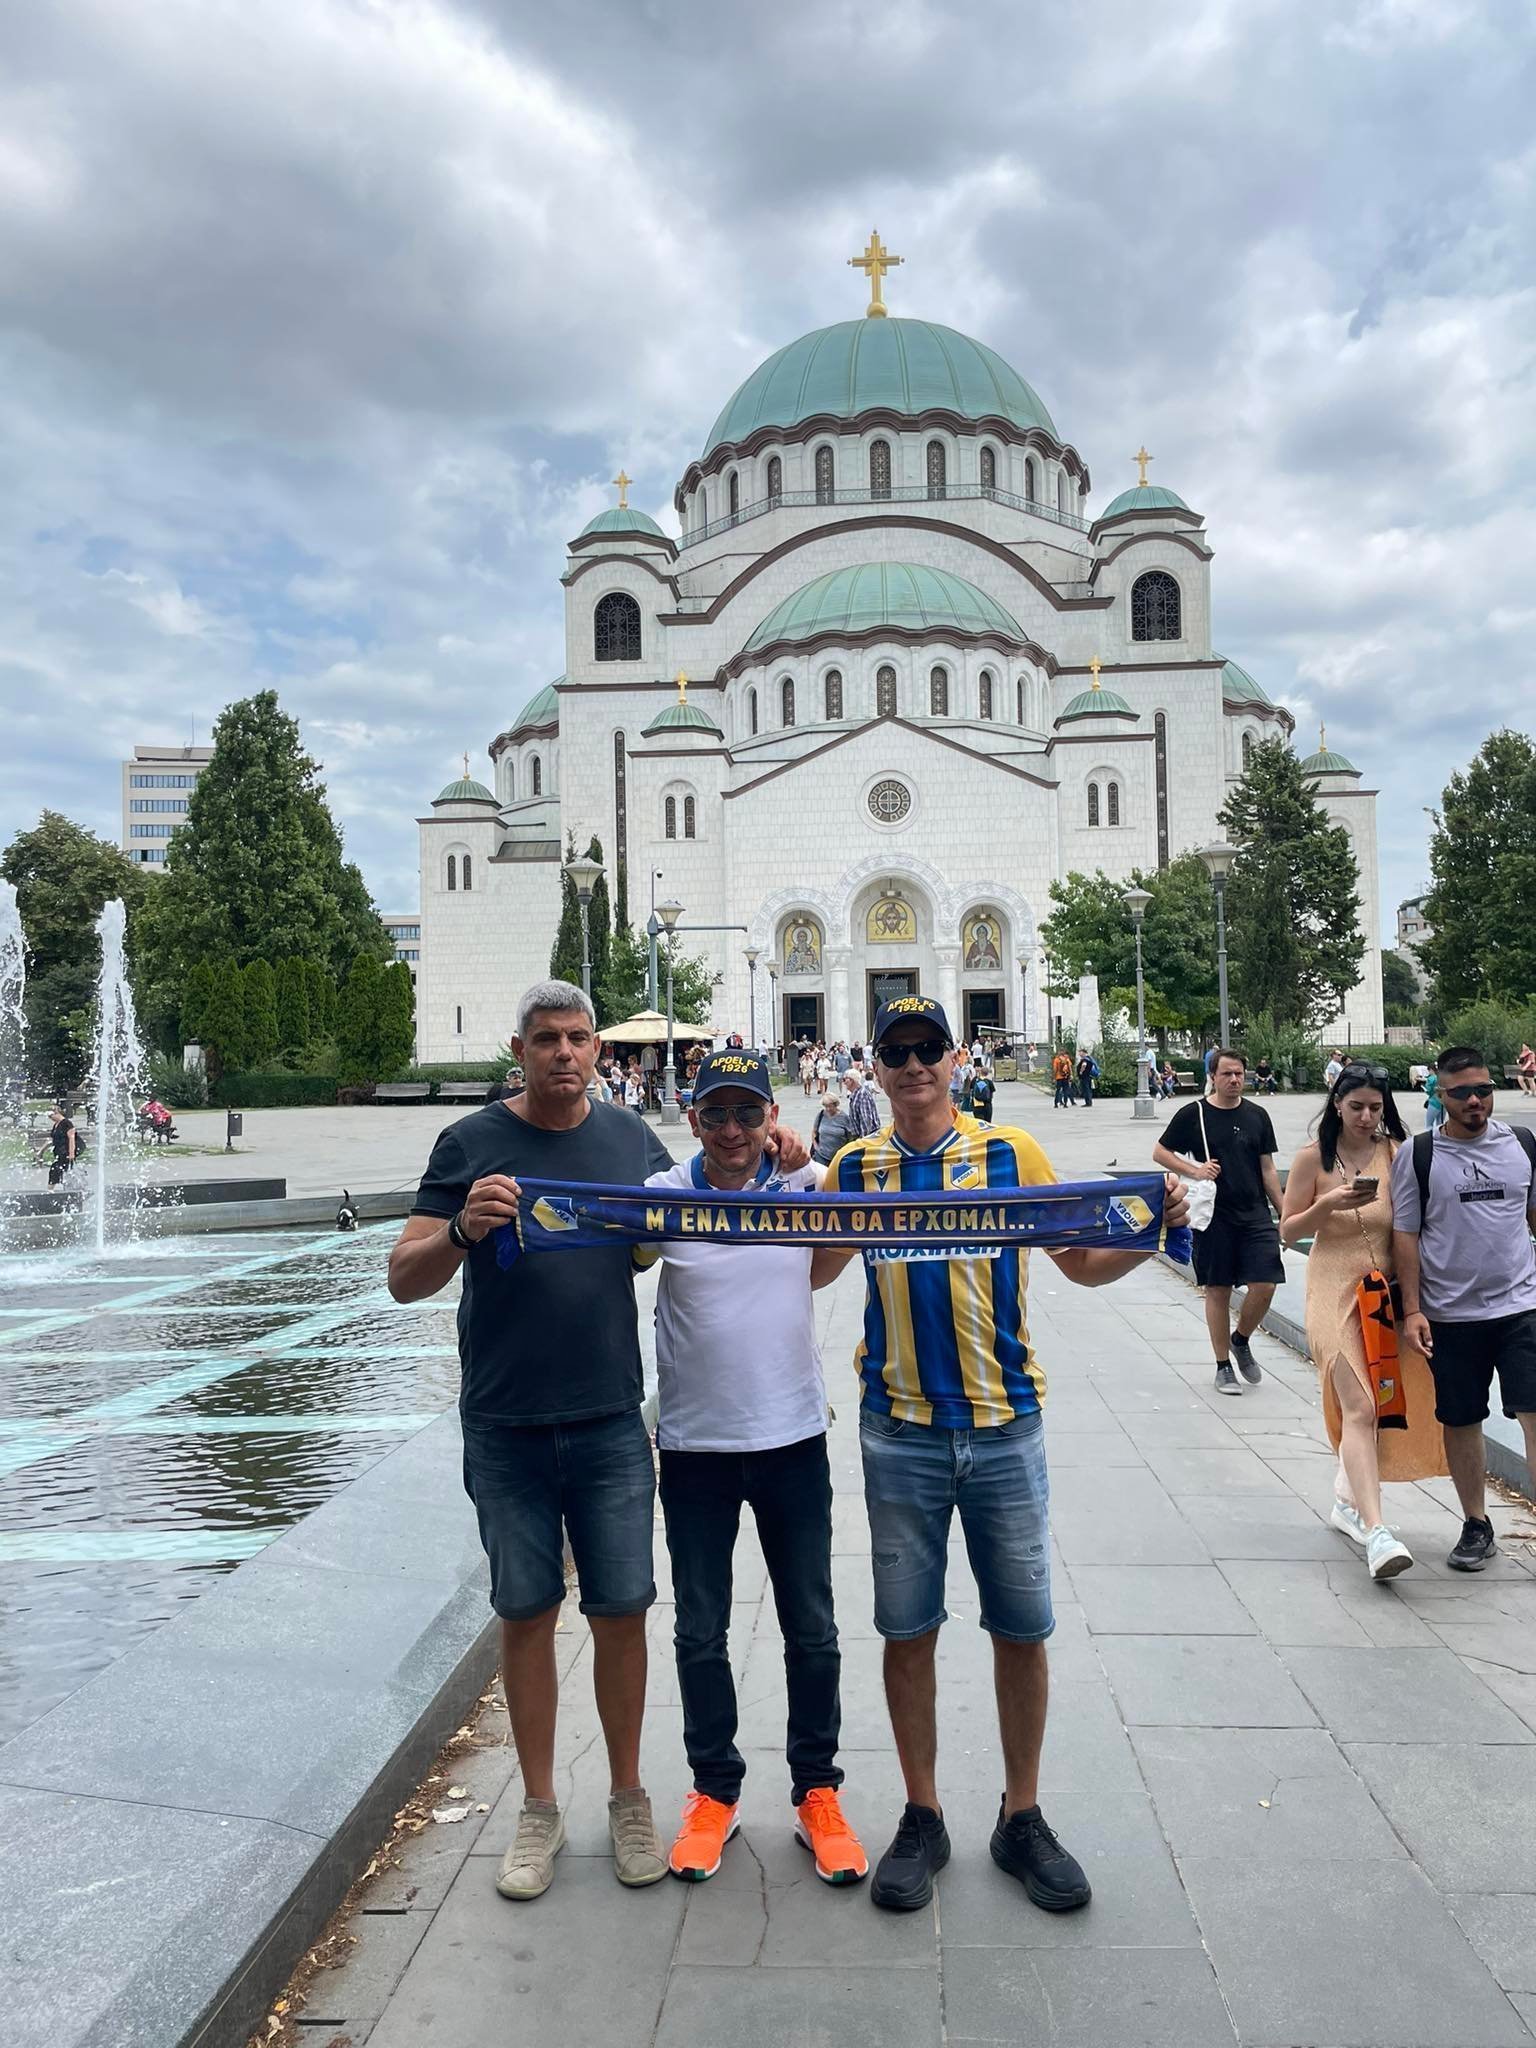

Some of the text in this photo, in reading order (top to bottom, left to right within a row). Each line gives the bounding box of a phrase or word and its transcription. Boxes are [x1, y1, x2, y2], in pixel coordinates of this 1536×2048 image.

[887, 997, 935, 1012] APOEL FC
[898, 1003, 925, 1012] 1926
[710, 1056, 759, 1070] APOEL FC
[721, 1063, 748, 1073] 1926
[681, 1207, 731, 1232] ΕΝΑ
[740, 1208, 842, 1232] ΚΑΣΚΟΛ
[851, 1210, 884, 1232] ΘΑ
